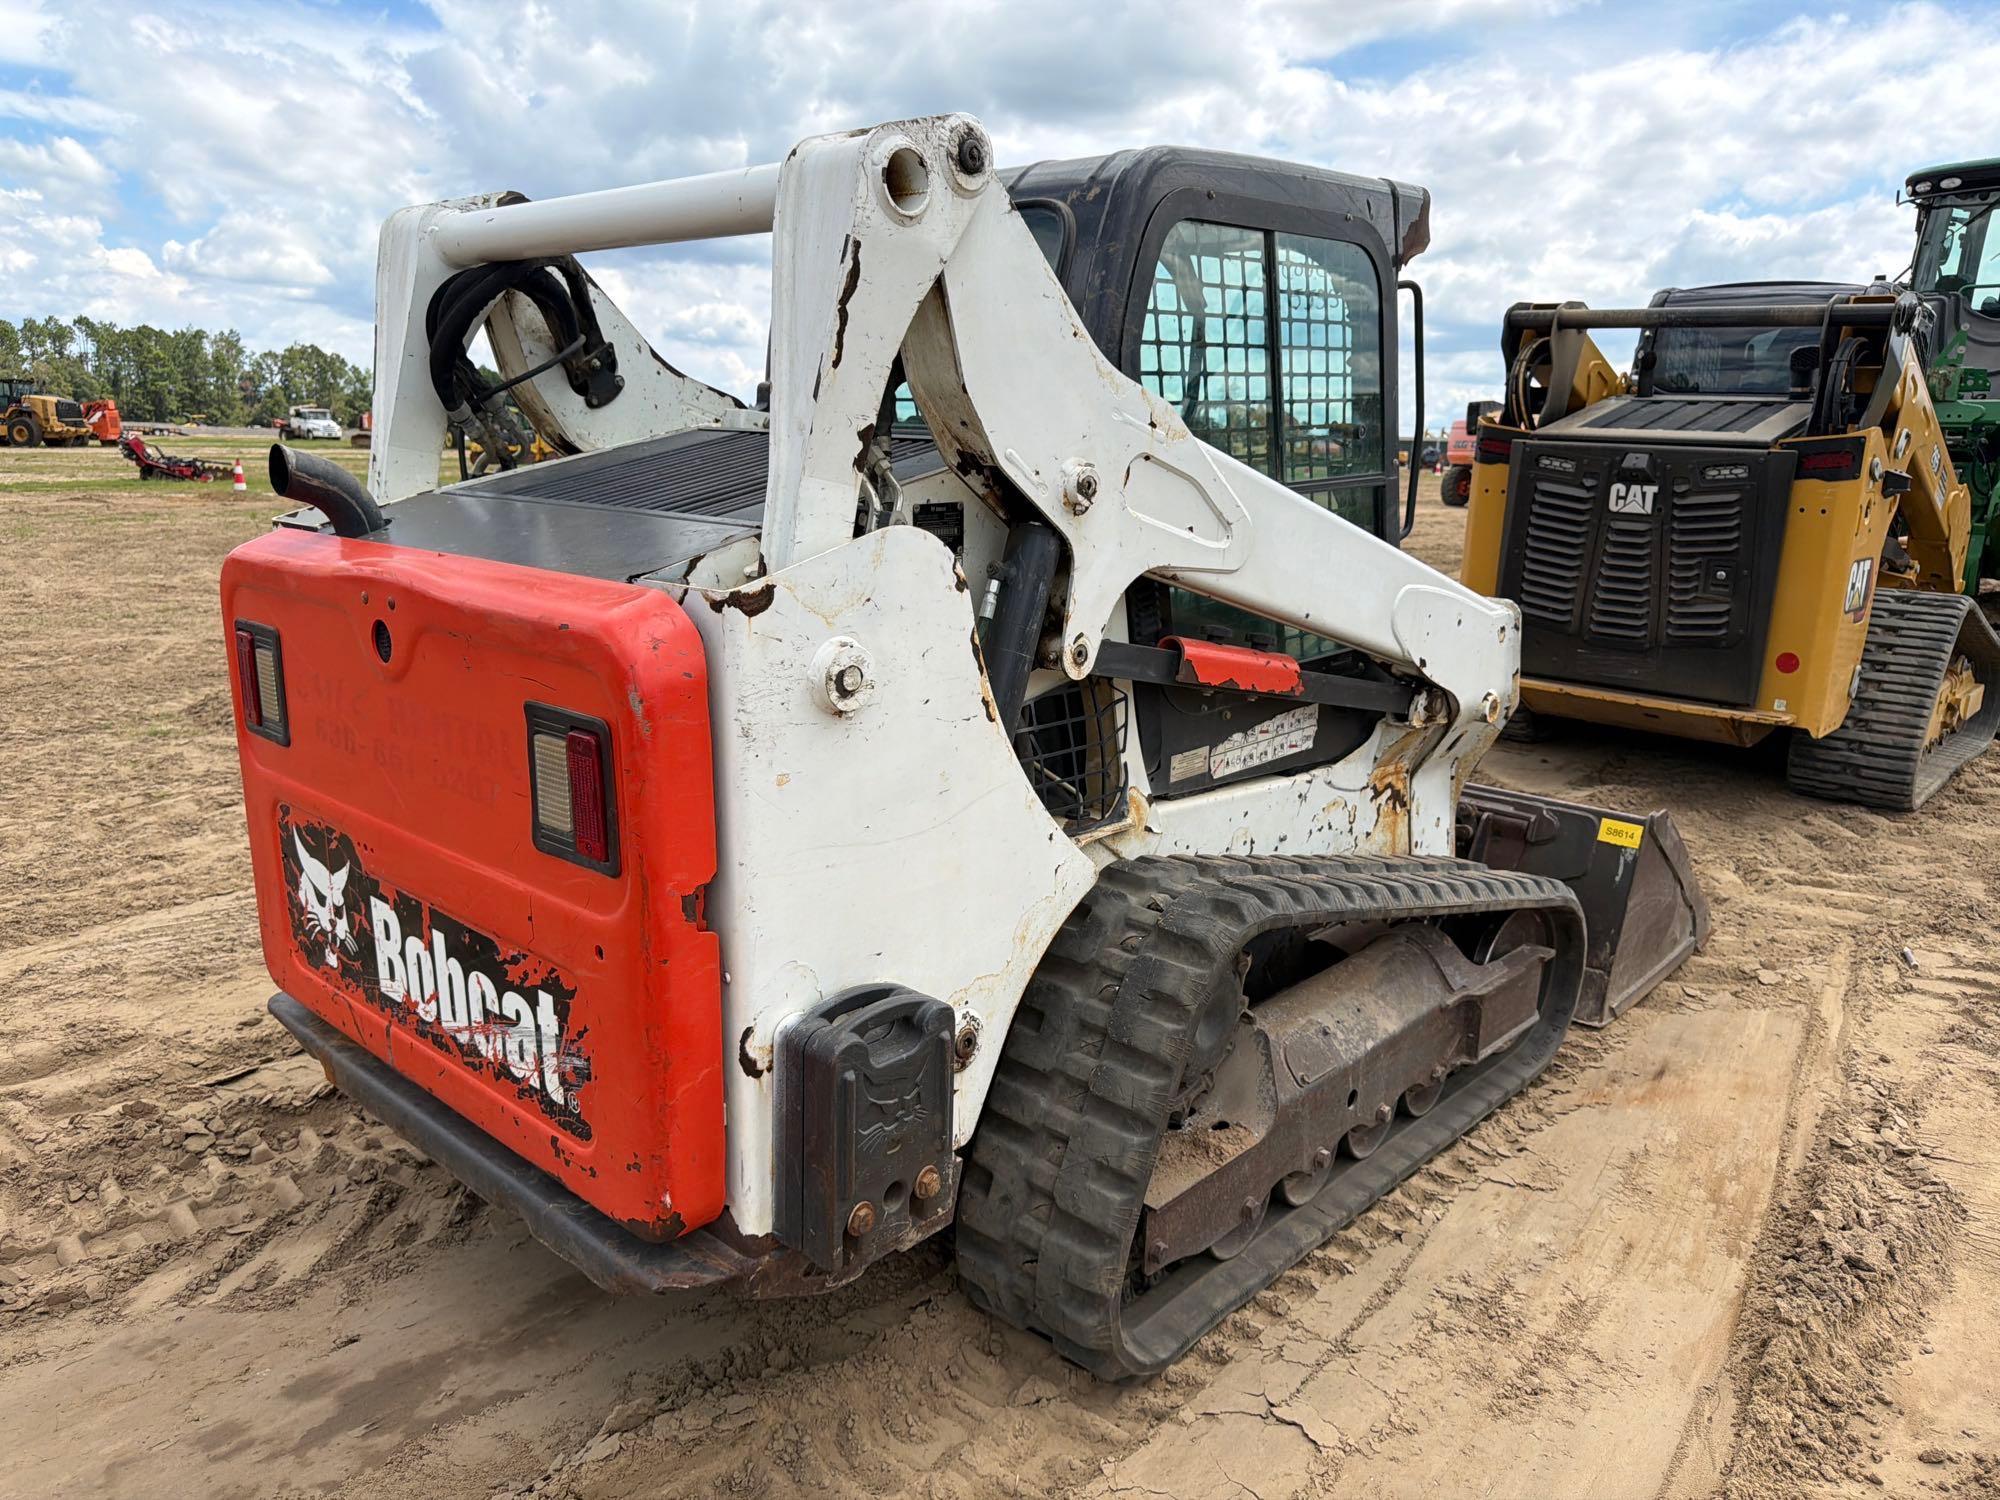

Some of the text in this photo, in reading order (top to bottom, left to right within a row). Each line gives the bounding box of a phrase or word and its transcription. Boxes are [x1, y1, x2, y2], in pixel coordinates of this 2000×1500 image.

[1609, 483, 1659, 515] CAT
[1845, 559, 1872, 612] CAT
[1605, 826, 1635, 840] S8614
[370, 895, 565, 1105] Bobcat
